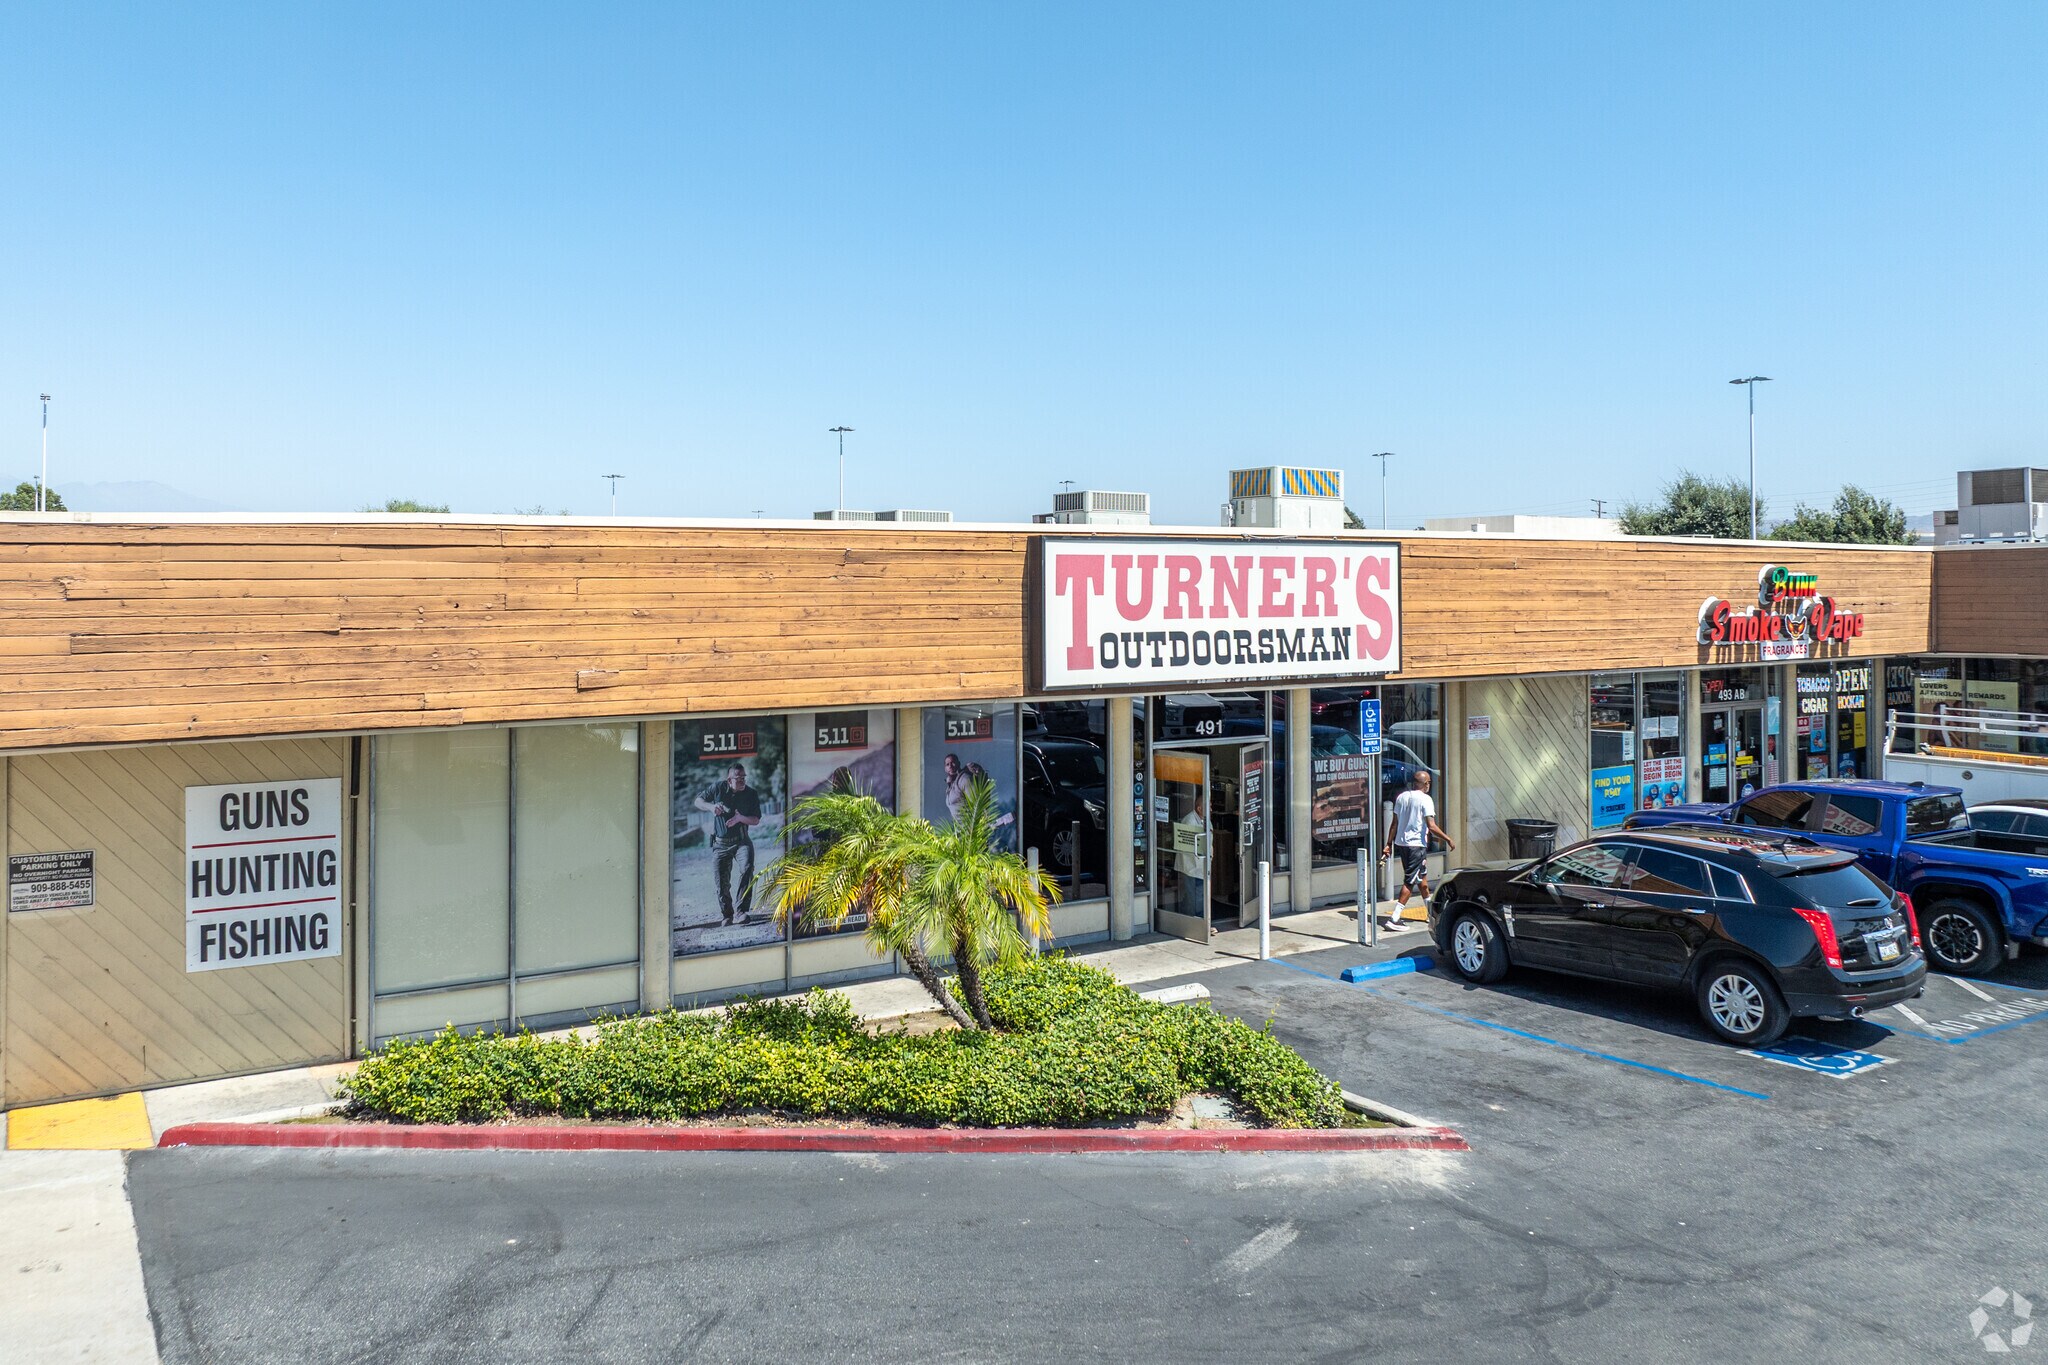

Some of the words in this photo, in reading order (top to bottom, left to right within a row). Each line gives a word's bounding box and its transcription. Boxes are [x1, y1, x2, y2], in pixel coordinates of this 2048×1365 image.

[1056, 554, 1393, 671] TURNER'S
[1708, 599, 1781, 642] Smoke
[1809, 596, 1864, 643] Vape
[1100, 627, 1351, 669] OUTDOORSMAN
[1762, 643, 1808, 656] FRAGRANCES
[1706, 680, 1725, 692] OPEN
[1797, 677, 1830, 693] TOBACCO
[1718, 689, 1732, 700] 493
[1734, 688, 1745, 700] AB
[1837, 694, 1865, 709] HOOKAH
[1968, 692, 2006, 700] REWARDS
[1801, 697, 1828, 713] CIGAR
[948, 719, 976, 737] 5.11
[1195, 719, 1224, 735] 491
[703, 733, 737, 752] 5.11
[818, 727, 849, 746] 5.11
[1314, 760, 1328, 773] WE
[1329, 758, 1347, 772] BUY
[1347, 757, 1369, 771] GUNS
[1594, 778, 1611, 788] FIND
[1612, 775, 1631, 786] YOUR
[1643, 772, 1662, 781] BEGIN
[1664, 770, 1682, 778] BEGIN
[219, 787, 310, 832] GUNS
[11, 852, 92, 864] CUSTOMER/TENANT
[21, 862, 58, 871] PARKING
[60, 860, 83, 868] ONLY
[24, 869, 61, 877] OVERNIGHT
[191, 849, 337, 898] HUNTING
[31, 879, 91, 893] 909-888-5455
[847, 914, 865, 923] READY
[200, 912, 329, 962] FISHING
